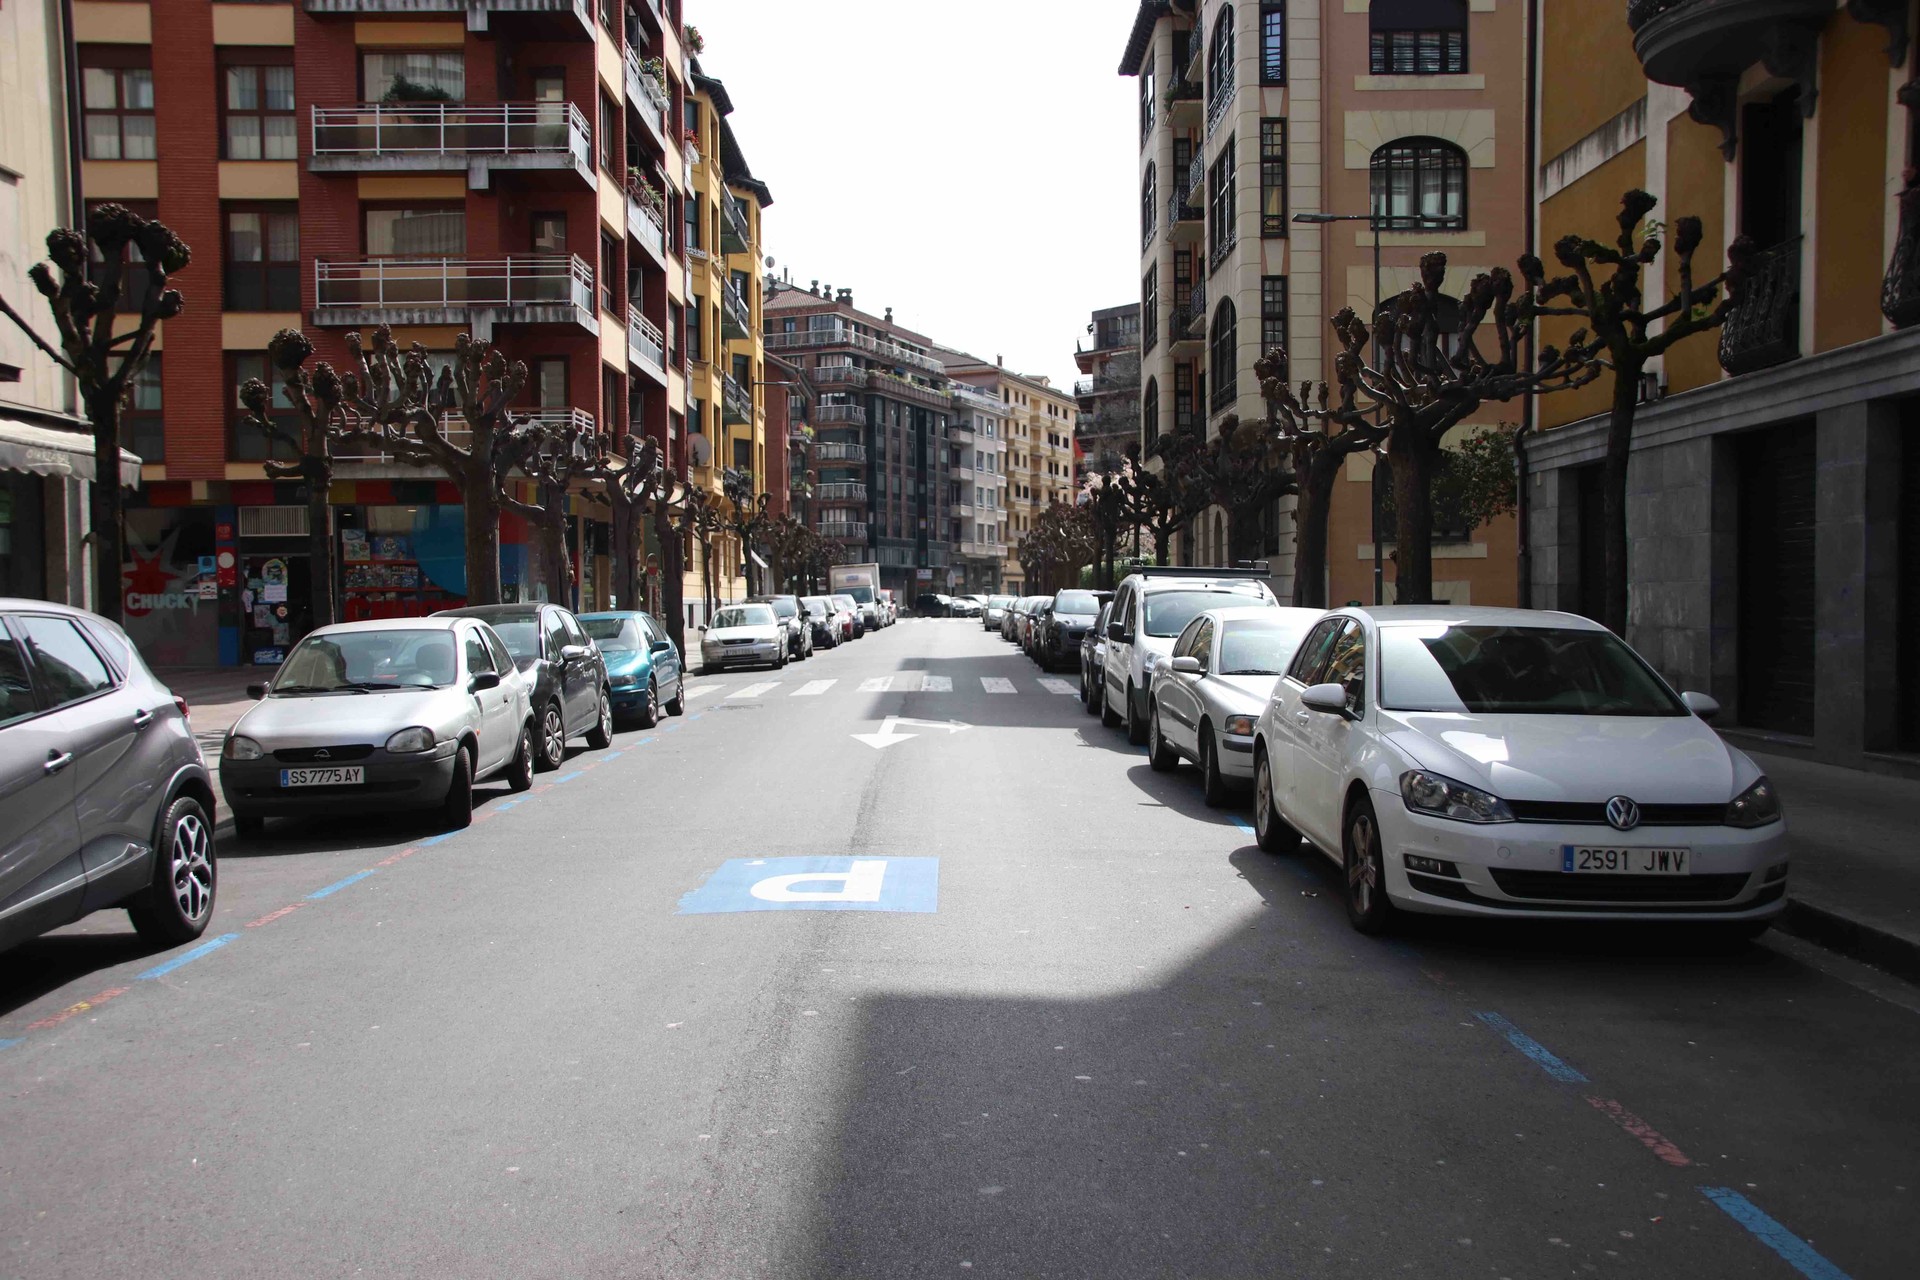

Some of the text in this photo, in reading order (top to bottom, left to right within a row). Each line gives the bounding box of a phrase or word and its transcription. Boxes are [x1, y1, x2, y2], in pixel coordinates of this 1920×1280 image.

[126, 592, 200, 616] CHUCKY
[291, 771, 307, 784] SS
[310, 769, 342, 783] 7775
[345, 768, 360, 782] AY
[1578, 849, 1628, 870] 2591
[1643, 850, 1684, 871] JWV
